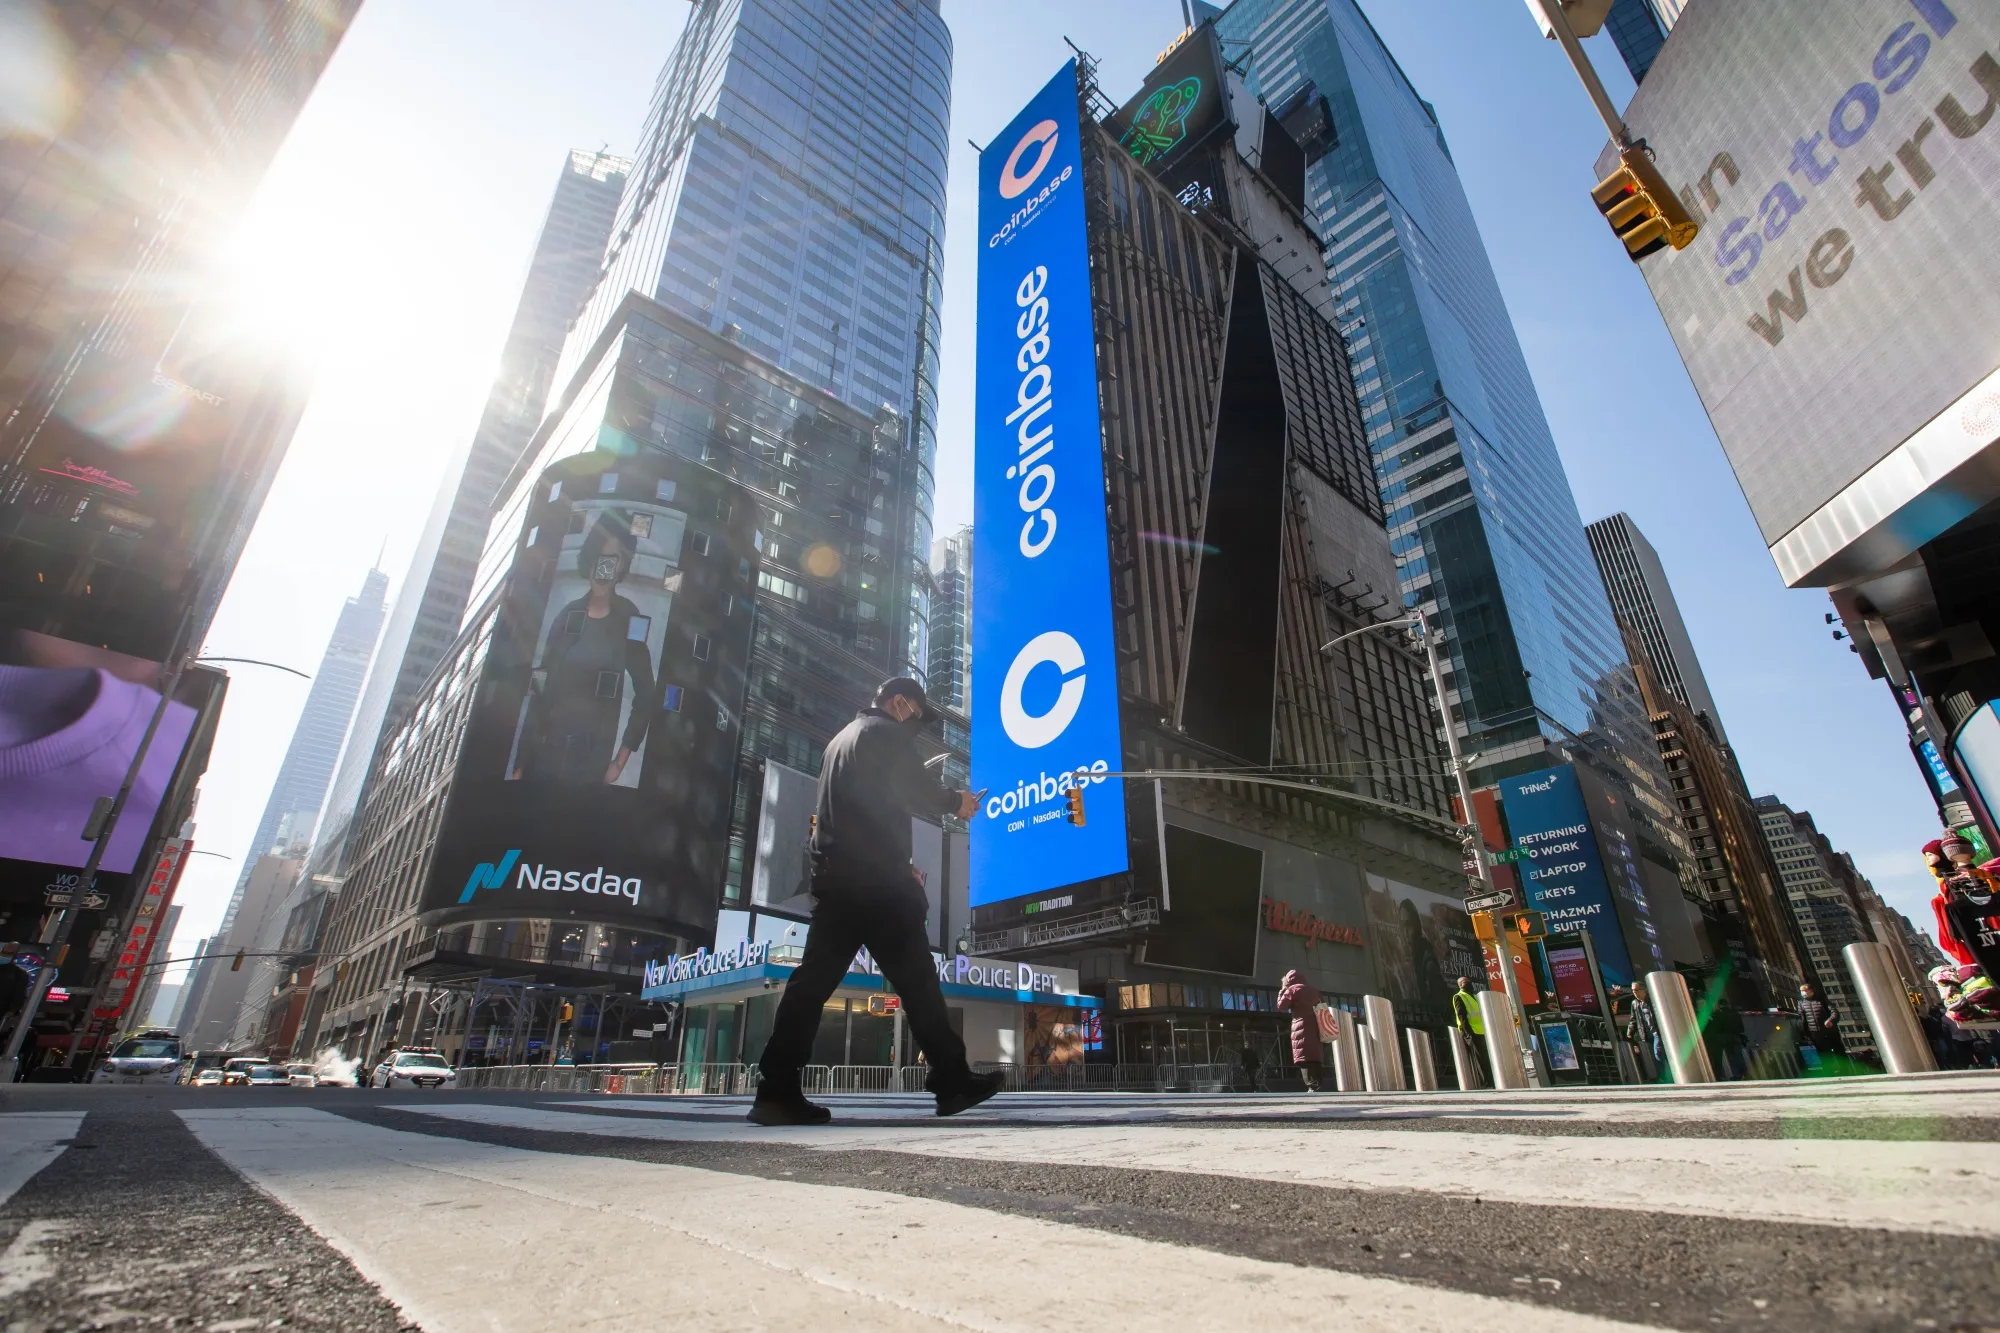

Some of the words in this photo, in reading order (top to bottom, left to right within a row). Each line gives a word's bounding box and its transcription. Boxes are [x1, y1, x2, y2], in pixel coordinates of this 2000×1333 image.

[989, 165, 1073, 248] coinbase
[1747, 226, 1855, 348] we
[1005, 264, 1058, 559] coinbase
[986, 759, 1108, 819] coinbase
[1519, 781, 1551, 795] TriNet
[1007, 819, 1025, 833] COIN
[1033, 809, 1061, 825] Nasdaq
[1518, 823, 1587, 845] RETURNING
[1497, 853, 1506, 863] W
[1509, 850, 1519, 860] 43
[1529, 849, 1539, 858] O
[1541, 841, 1580, 856] WORK
[148, 845, 179, 897] PARK
[1539, 861, 1587, 878] LAPTOP
[516, 863, 641, 906] Nasdaq
[1545, 885, 1576, 899] KEYS
[1469, 901, 1484, 909] ONE
[1491, 895, 1506, 904] WAY
[1550, 904, 1602, 920] HAZMAT
[1262, 898, 1366, 948] Walgreens
[1553, 920, 1587, 933] SUIT?
[1975, 917, 1989, 932] I
[113, 926, 147, 979] PARK
[1450, 949, 1474, 966] MARE
[643, 959, 667, 988] NEW
[667, 954, 694, 983] YORK
[694, 947, 732, 977] POLICE
[955, 954, 1011, 989] POLICE
[1017, 963, 1058, 994] DEPT
[1443, 960, 1485, 980] EASTTOWN
